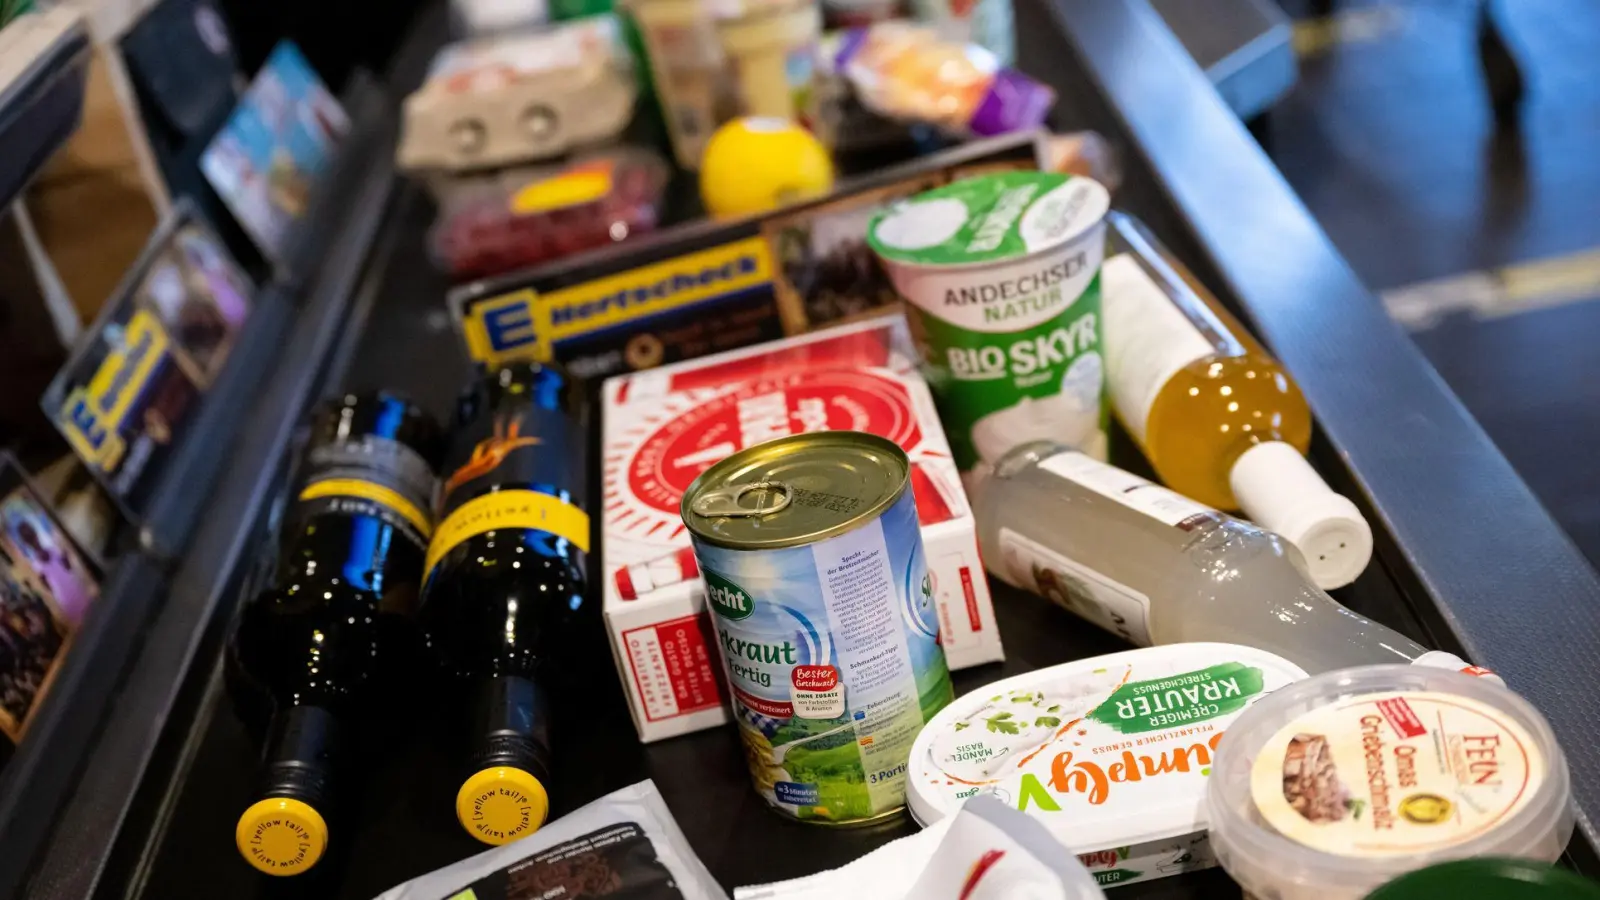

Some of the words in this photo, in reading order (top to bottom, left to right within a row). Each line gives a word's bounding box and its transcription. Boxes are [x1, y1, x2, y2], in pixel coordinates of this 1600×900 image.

[944, 252, 1086, 305] ANDECHSER
[984, 288, 1062, 322] NATUR
[947, 345, 1006, 376] BIO
[1010, 313, 1097, 375] SKYR
[838, 550, 879, 572] Brotzeitmacher
[842, 551, 861, 562] Specht
[709, 586, 747, 612] echt
[664, 640, 682, 676] GUSTO
[676, 628, 694, 668] DECISO
[646, 640, 672, 707] FRIZZANTE
[796, 668, 832, 679] Bester
[796, 678, 836, 688] Geschmack
[1133, 672, 1212, 696] STREICHGENUSS
[760, 704, 791, 714] verfeinert
[1115, 677, 1242, 720] KRÄUTER
[1150, 703, 1220, 728] CREMIGER
[956, 742, 984, 752] BASIS
[1092, 740, 1133, 756] GENUSS
[1136, 724, 1214, 747] PFLANZLICHER
[952, 748, 993, 762] MANDEL
[1394, 744, 1417, 788] Omas
[870, 774, 876, 784] 3
[880, 763, 908, 781] Porti
[1360, 714, 1394, 831] Griebenschmalz
[784, 784, 789, 794] 3
[790, 788, 818, 796] Minuten
[956, 786, 980, 799] gan
[1018, 773, 1062, 812] V
[472, 789, 496, 821] [yellow
[250, 820, 281, 845] [yellow
